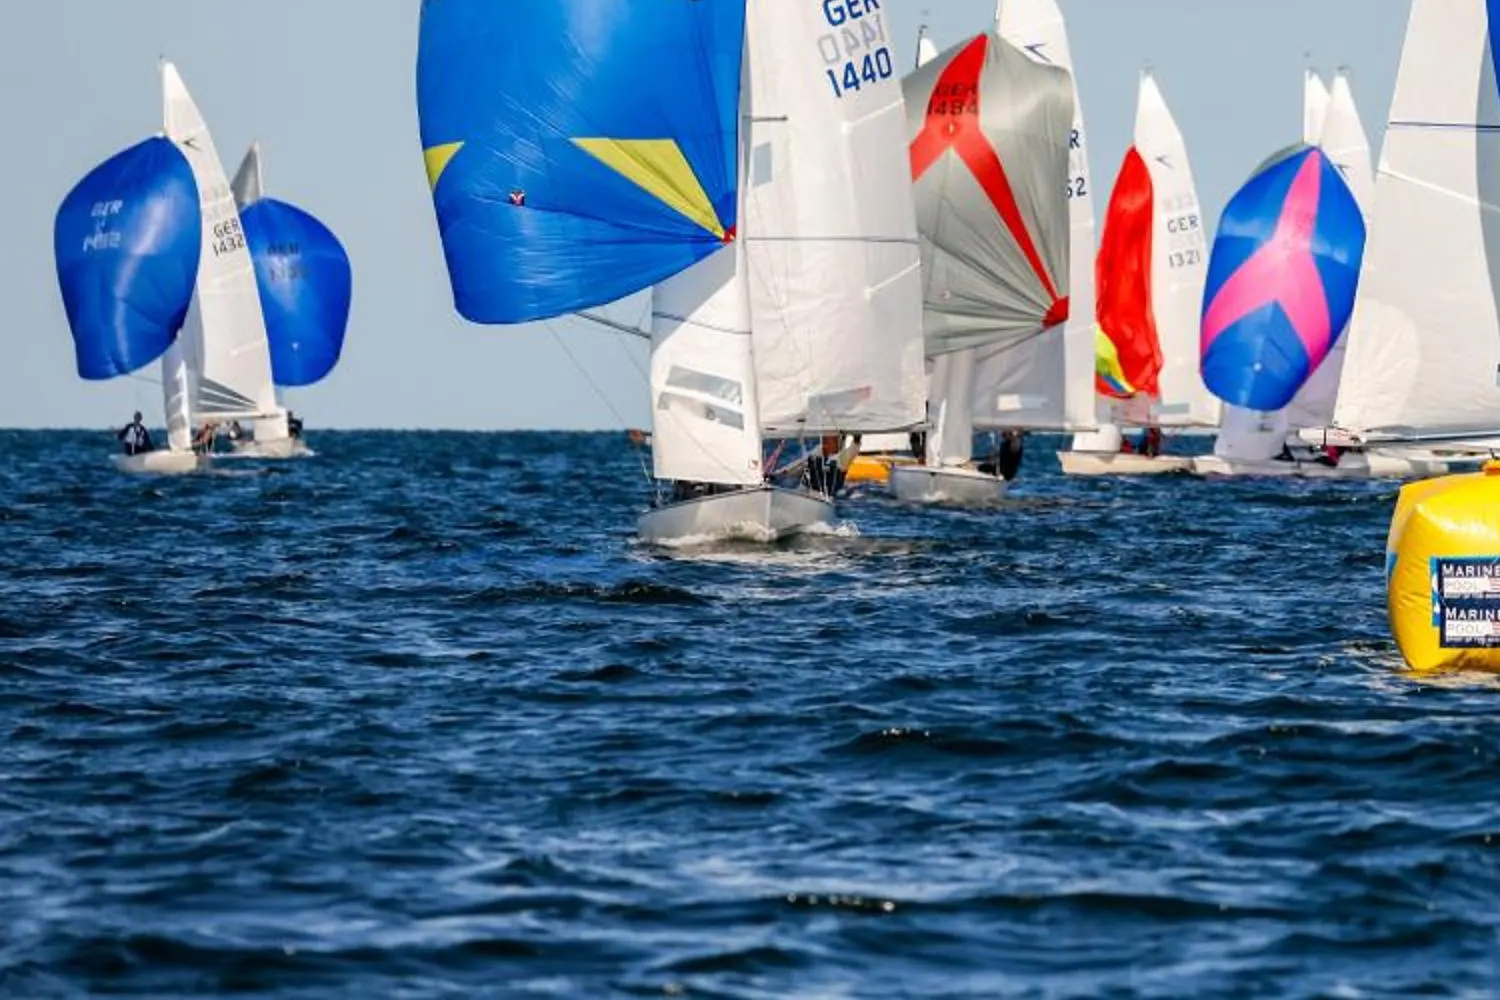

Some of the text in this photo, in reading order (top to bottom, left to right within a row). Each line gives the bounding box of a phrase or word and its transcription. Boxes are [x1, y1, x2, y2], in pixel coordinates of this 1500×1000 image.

[827, 47, 893, 98] 1440
[213, 217, 239, 239] GER
[1166, 215, 1199, 234] GER
